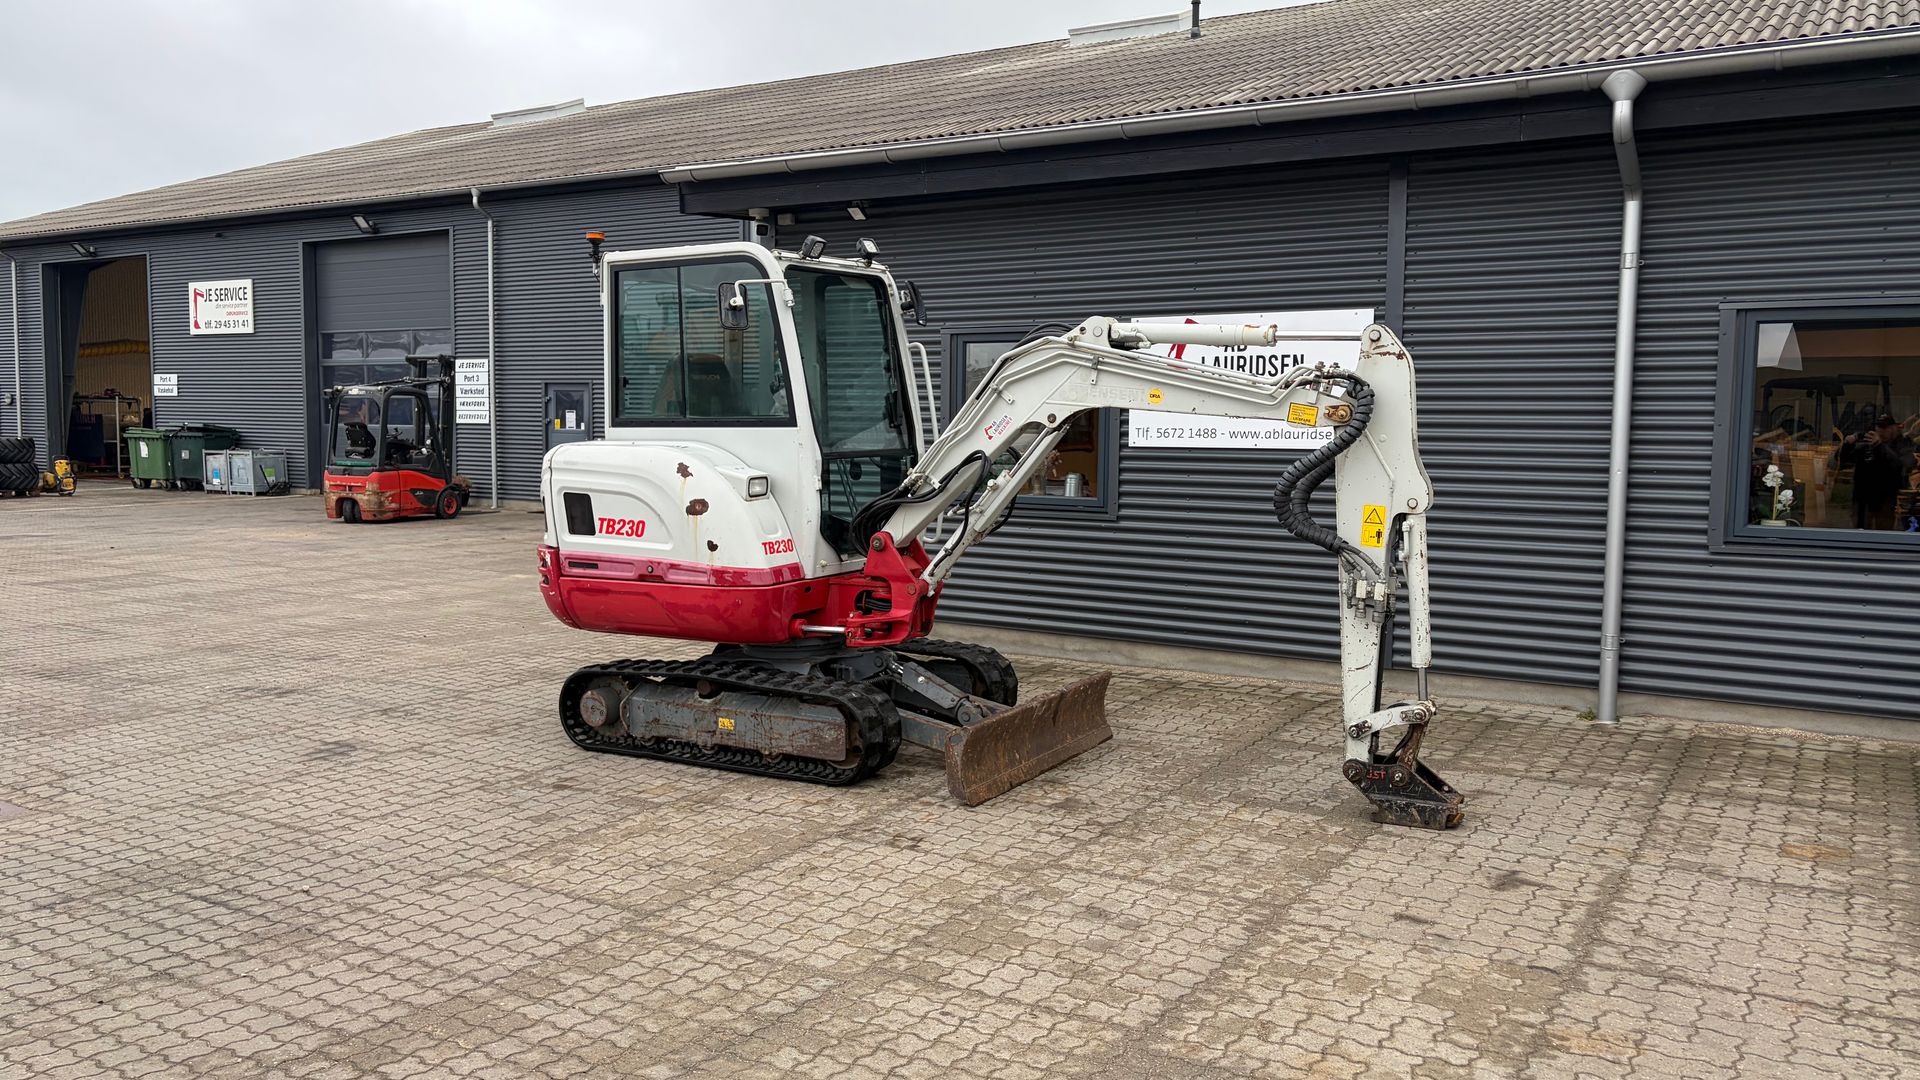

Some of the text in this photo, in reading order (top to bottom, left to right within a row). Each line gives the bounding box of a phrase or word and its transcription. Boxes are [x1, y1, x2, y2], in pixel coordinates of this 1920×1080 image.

[204, 287, 248, 302] JE SERVICE
[214, 320, 222, 329] 29
[223, 320, 231, 329] 45
[232, 319, 240, 329] 31
[241, 319, 249, 328] 41
[464, 374, 480, 382] Port 3
[459, 387, 485, 395] Værksted
[1135, 427, 1152, 440] Tlf.
[1156, 427, 1185, 439] 5672
[1188, 427, 1217, 439] 1488
[598, 517, 646, 538] TB230
[761, 538, 794, 556] TB230
